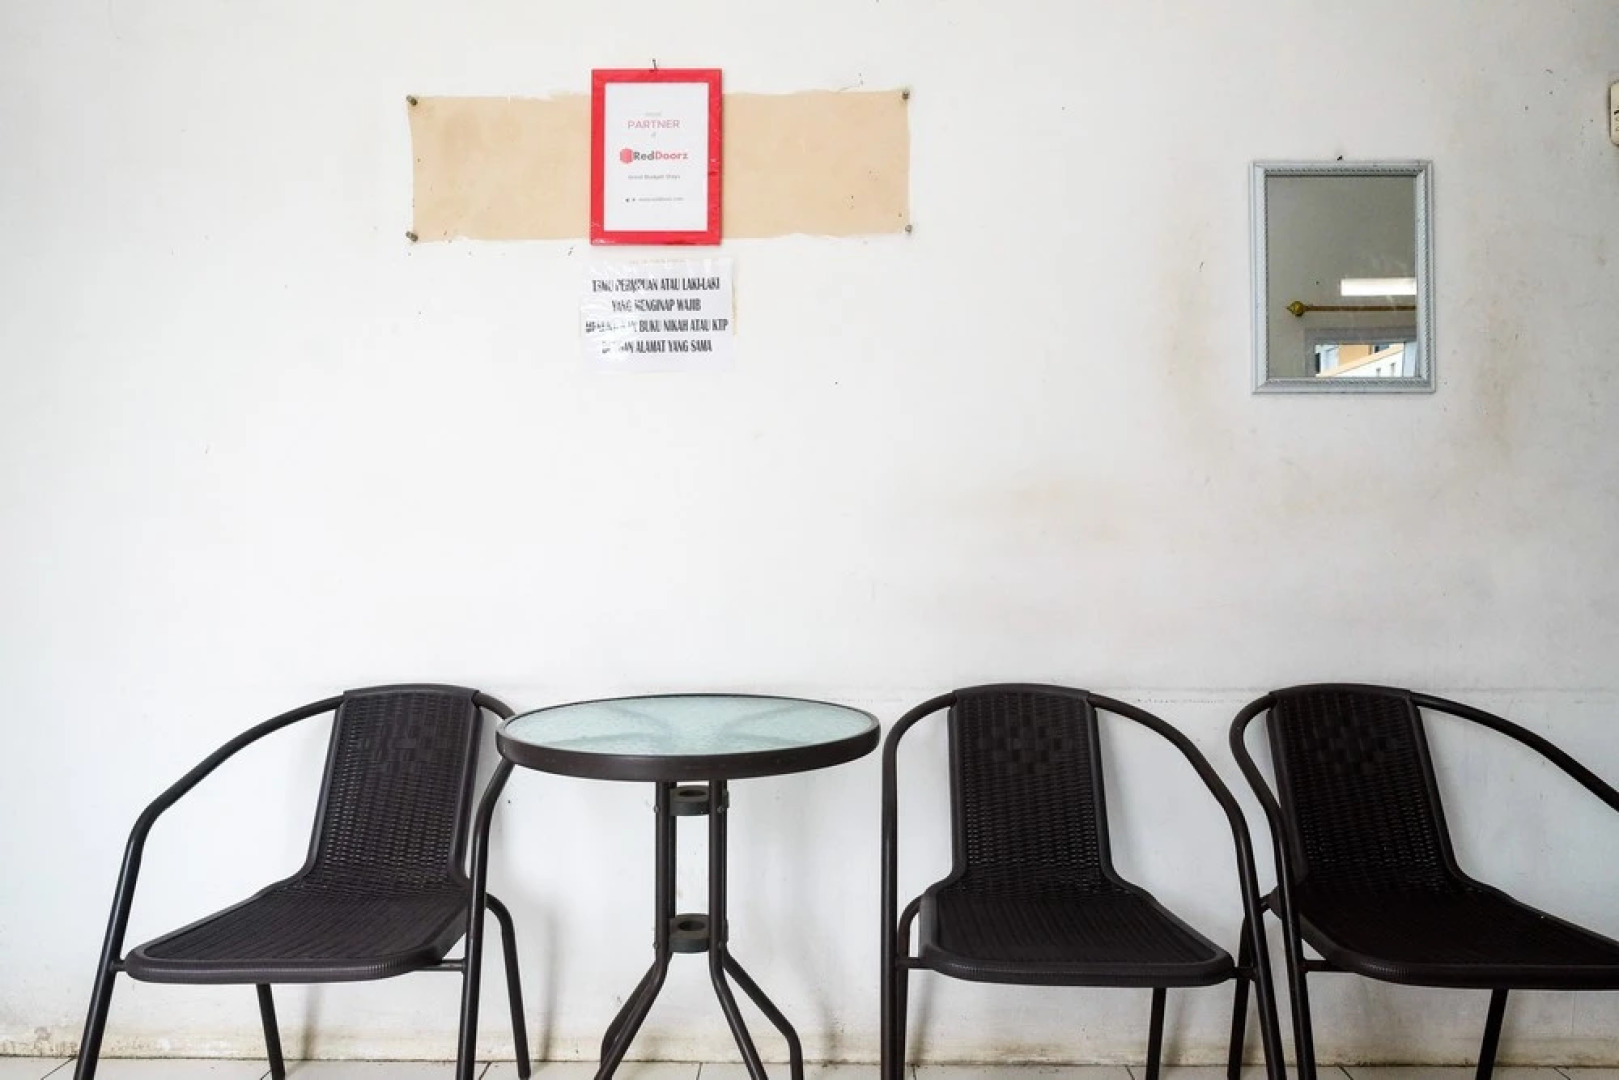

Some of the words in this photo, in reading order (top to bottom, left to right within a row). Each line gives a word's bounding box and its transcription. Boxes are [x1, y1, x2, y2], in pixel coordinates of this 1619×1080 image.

[627, 119, 681, 129] PARTNER
[632, 150, 689, 161] RedDoorz
[660, 277, 681, 291] ATAU
[682, 276, 720, 291] LAKI-LAKI
[634, 298, 675, 312] MENGINAP
[677, 298, 702, 311] WAJIB
[639, 319, 661, 333] BUKU
[663, 319, 689, 332] NIKAH
[690, 319, 710, 332] ATAU
[712, 318, 729, 331] KTP
[636, 339, 666, 353] ALAMAT
[667, 339, 689, 353] YANG
[690, 339, 713, 352] SAMA
